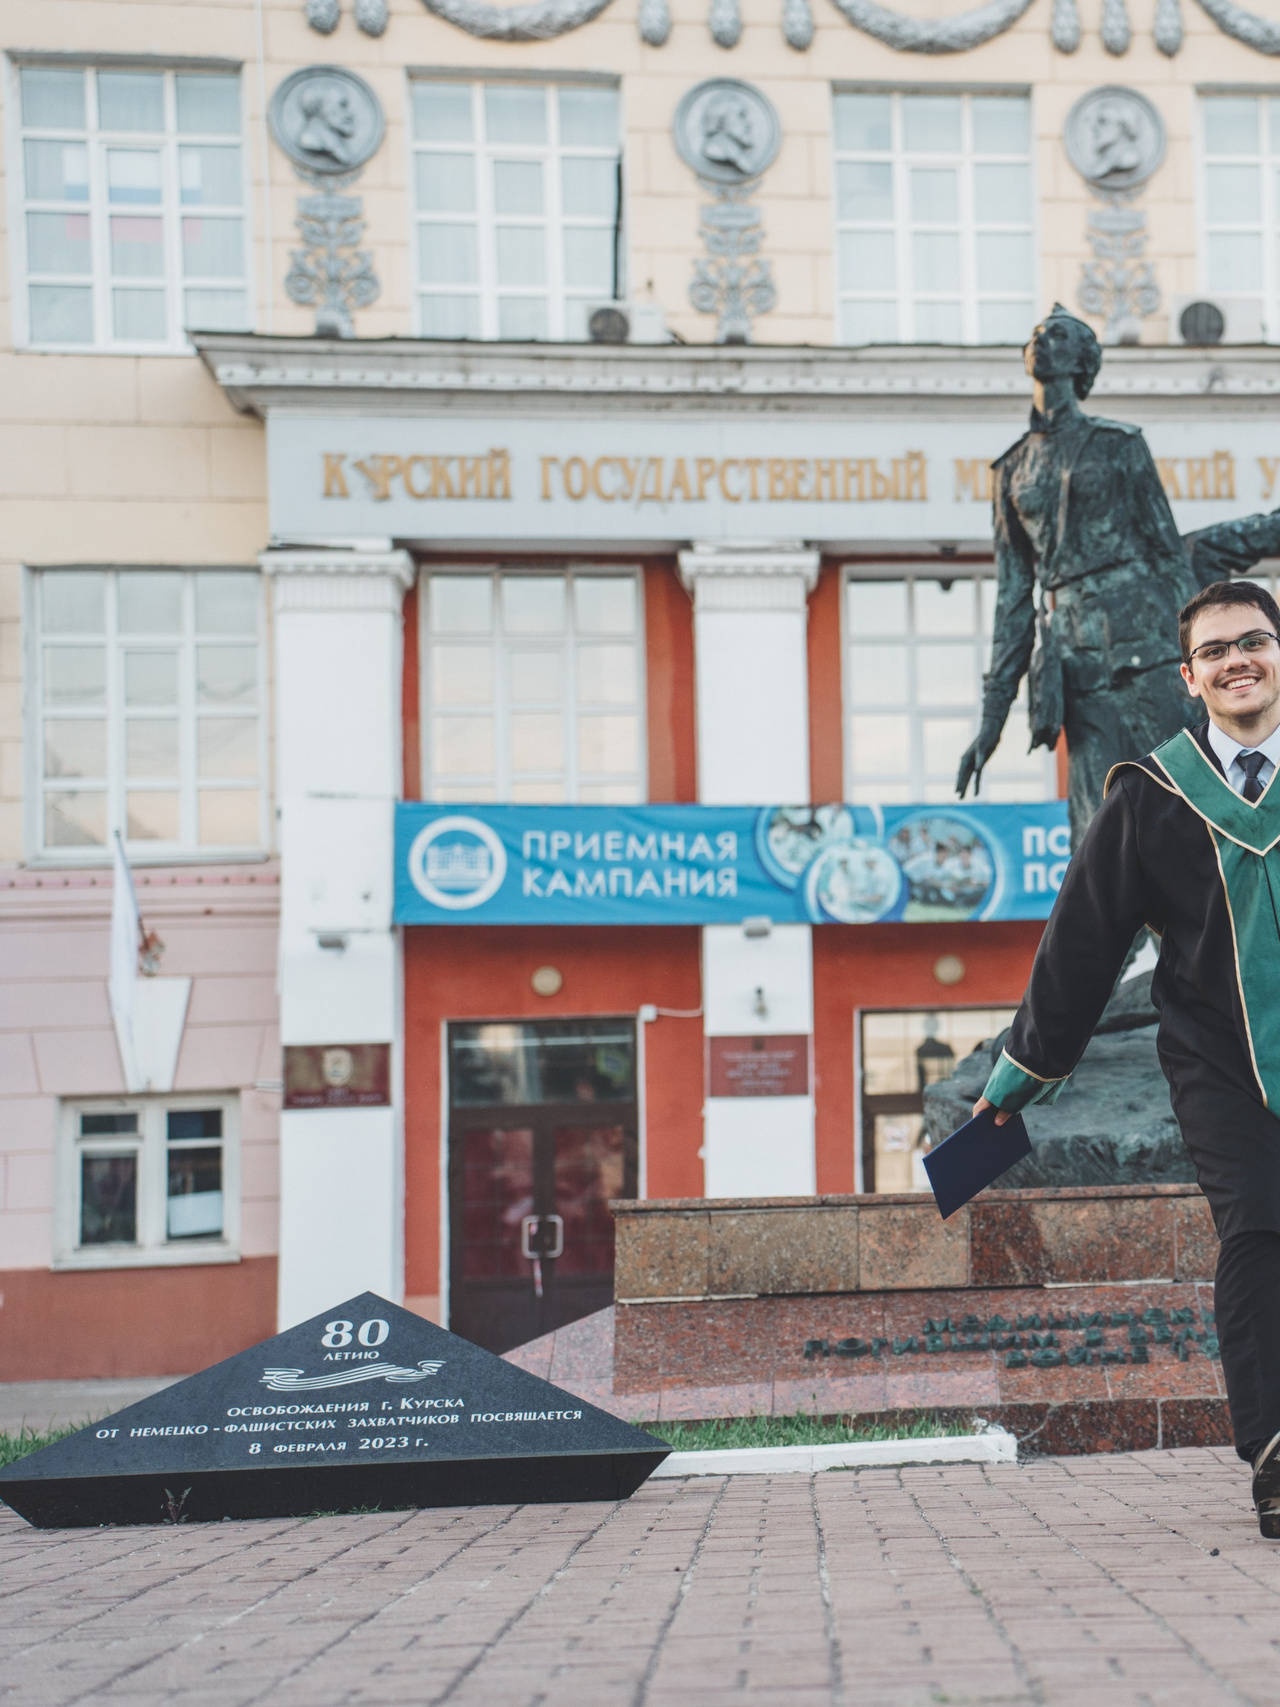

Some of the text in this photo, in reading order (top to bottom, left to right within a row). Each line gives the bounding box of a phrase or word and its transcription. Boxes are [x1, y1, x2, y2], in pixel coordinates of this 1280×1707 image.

[321, 448, 512, 501] КУРСКИЙ
[540, 450, 928, 508] ГОСУДАРСТВЕННЫЙ
[522, 831, 738, 861] ПРИЕМНАЯ
[1022, 826, 1070, 857] ПО
[522, 867, 738, 898] КАМПАНИЯ
[1022, 861, 1067, 893] ПО
[321, 1318, 390, 1348] 80
[803, 1329, 1061, 1360] ПОГИБШИМ
[323, 1350, 380, 1361] ЛЕТИЮ
[226, 1402, 370, 1418] ОСВОБОЖДЕНИЯ
[95, 1428, 120, 1440] ОТ
[347, 1414, 460, 1429] ЗАХВАТЧИКОВ
[248, 1442, 262, 1455] 8
[272, 1441, 347, 1454] ФЕВРАЛЯ
[358, 1436, 409, 1450] 2023
